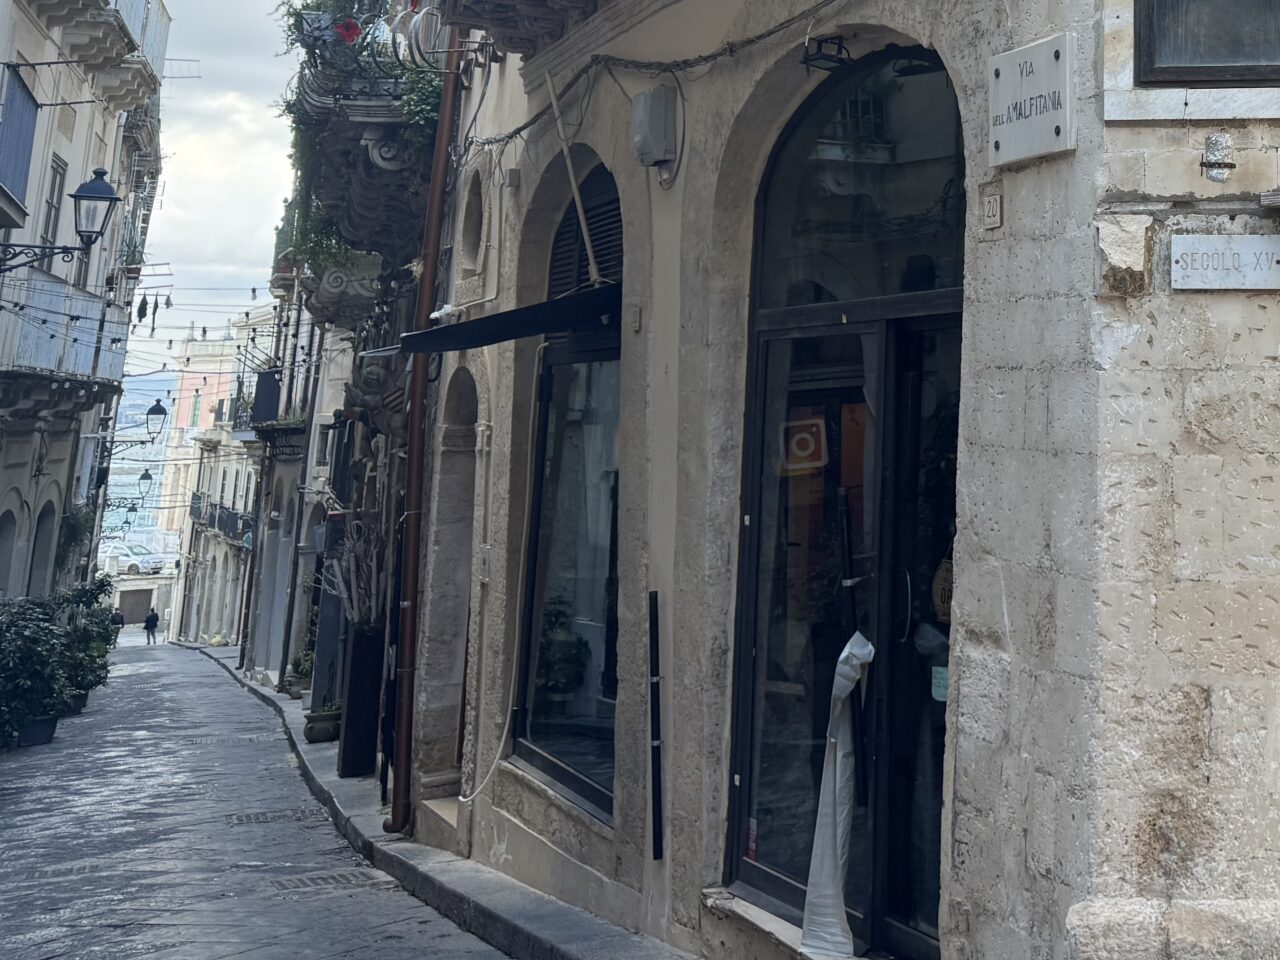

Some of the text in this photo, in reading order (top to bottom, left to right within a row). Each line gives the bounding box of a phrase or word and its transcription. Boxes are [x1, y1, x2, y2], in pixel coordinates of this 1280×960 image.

[1018, 60, 1034, 78] VIA
[986, 198, 998, 218] 20
[1180, 251, 1276, 271] SECOLO XV
